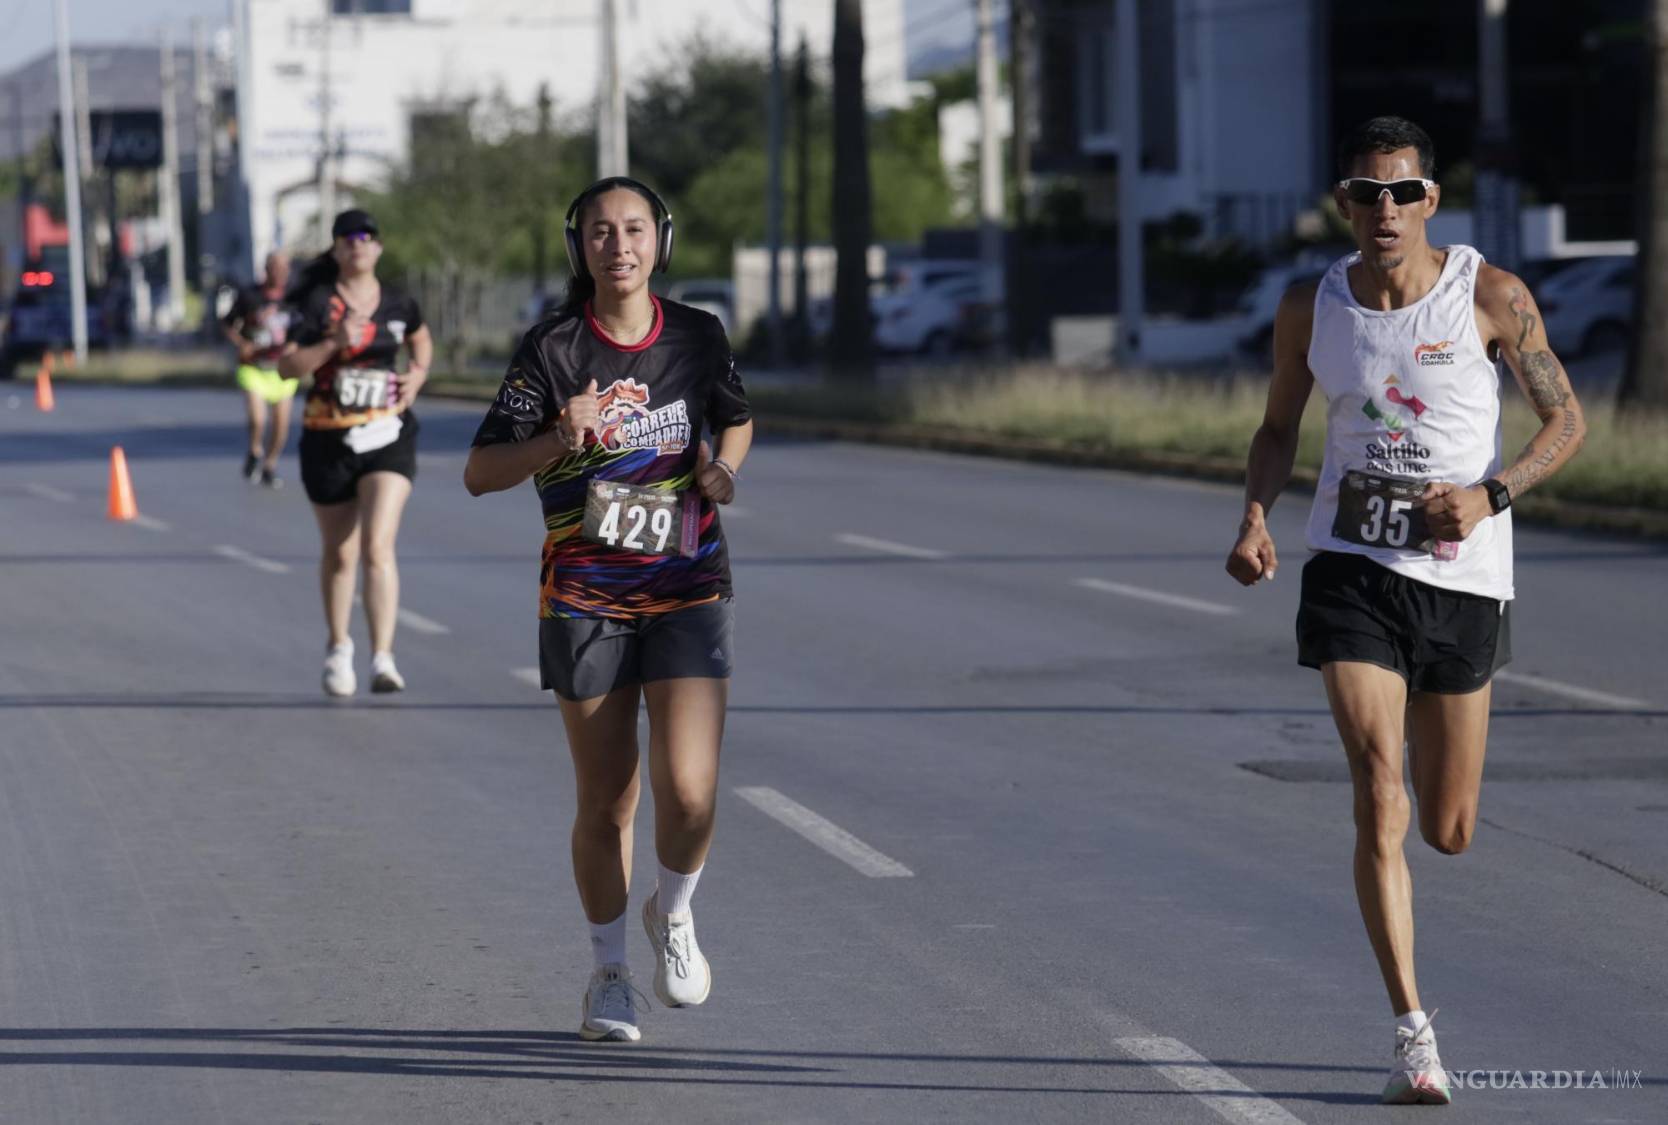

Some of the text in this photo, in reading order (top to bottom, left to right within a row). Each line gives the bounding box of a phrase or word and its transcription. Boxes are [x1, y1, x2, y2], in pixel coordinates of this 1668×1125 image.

[1421, 352, 1455, 361] CROC
[340, 376, 385, 407] 577
[1365, 442, 1431, 460] Saltillo
[598, 501, 672, 553] 429
[1360, 495, 1413, 547] 35
